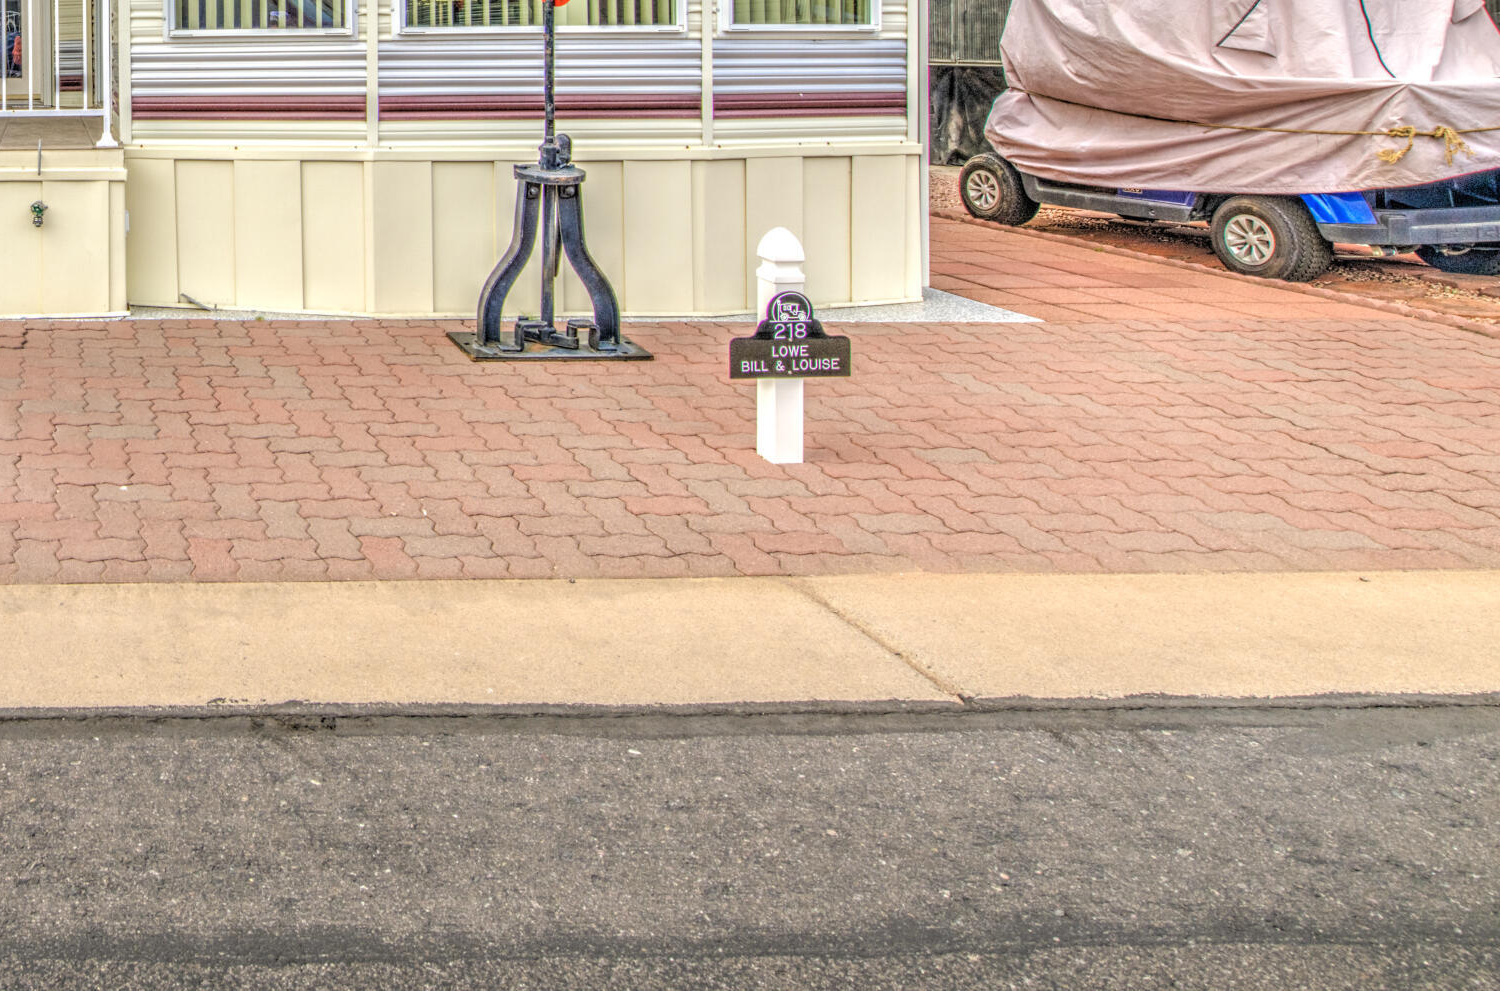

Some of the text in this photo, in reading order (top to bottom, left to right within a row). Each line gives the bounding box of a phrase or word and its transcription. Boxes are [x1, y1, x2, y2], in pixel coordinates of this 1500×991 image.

[774, 323, 808, 339] 218
[772, 345, 810, 357] LOWE
[741, 358, 840, 372] BILL & LOUISE
